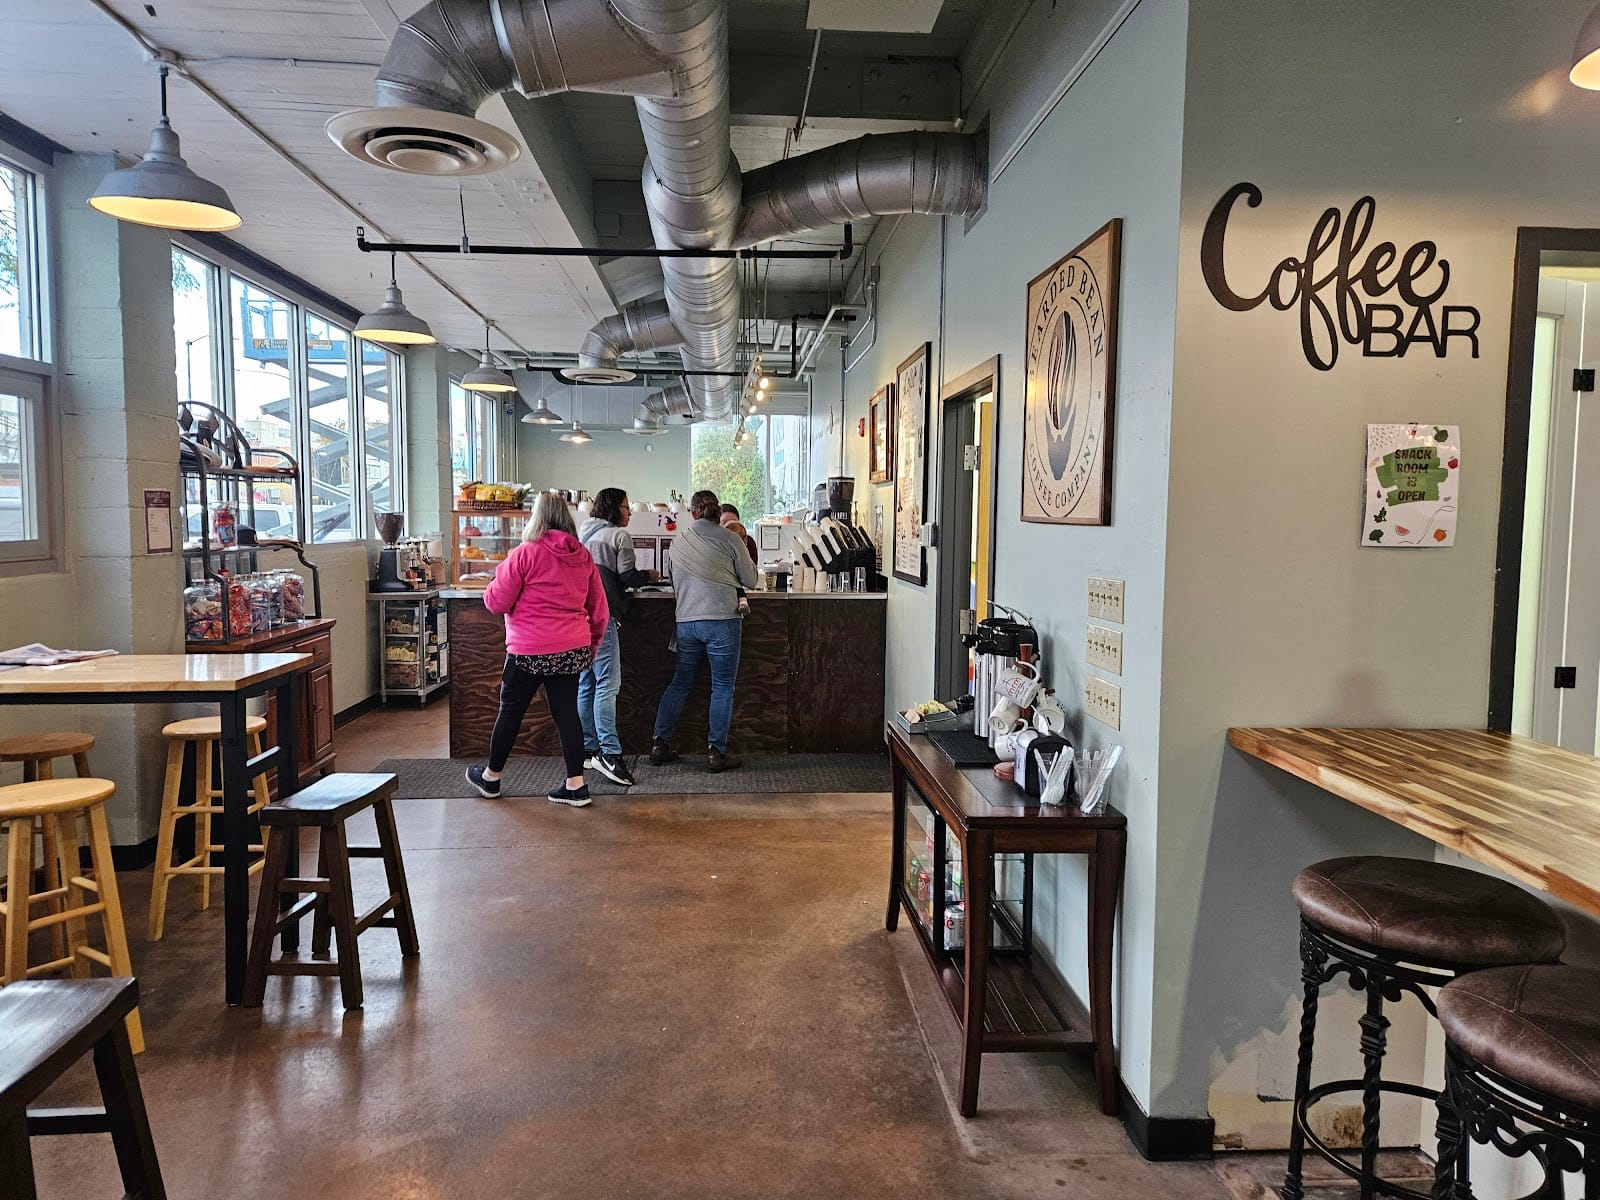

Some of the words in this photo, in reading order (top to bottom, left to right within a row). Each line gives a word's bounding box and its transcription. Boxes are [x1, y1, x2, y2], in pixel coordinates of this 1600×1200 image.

[1201, 182, 1450, 371] Coffee
[1079, 269, 1104, 358] BEAN
[1363, 304, 1480, 358] BAR
[1030, 442, 1051, 506] COFFEE
[1055, 427, 1095, 509] COMPANY
[1395, 449, 1432, 460] SNACK
[1397, 463, 1429, 474] ROOM
[1397, 491, 1425, 501] OPEN
